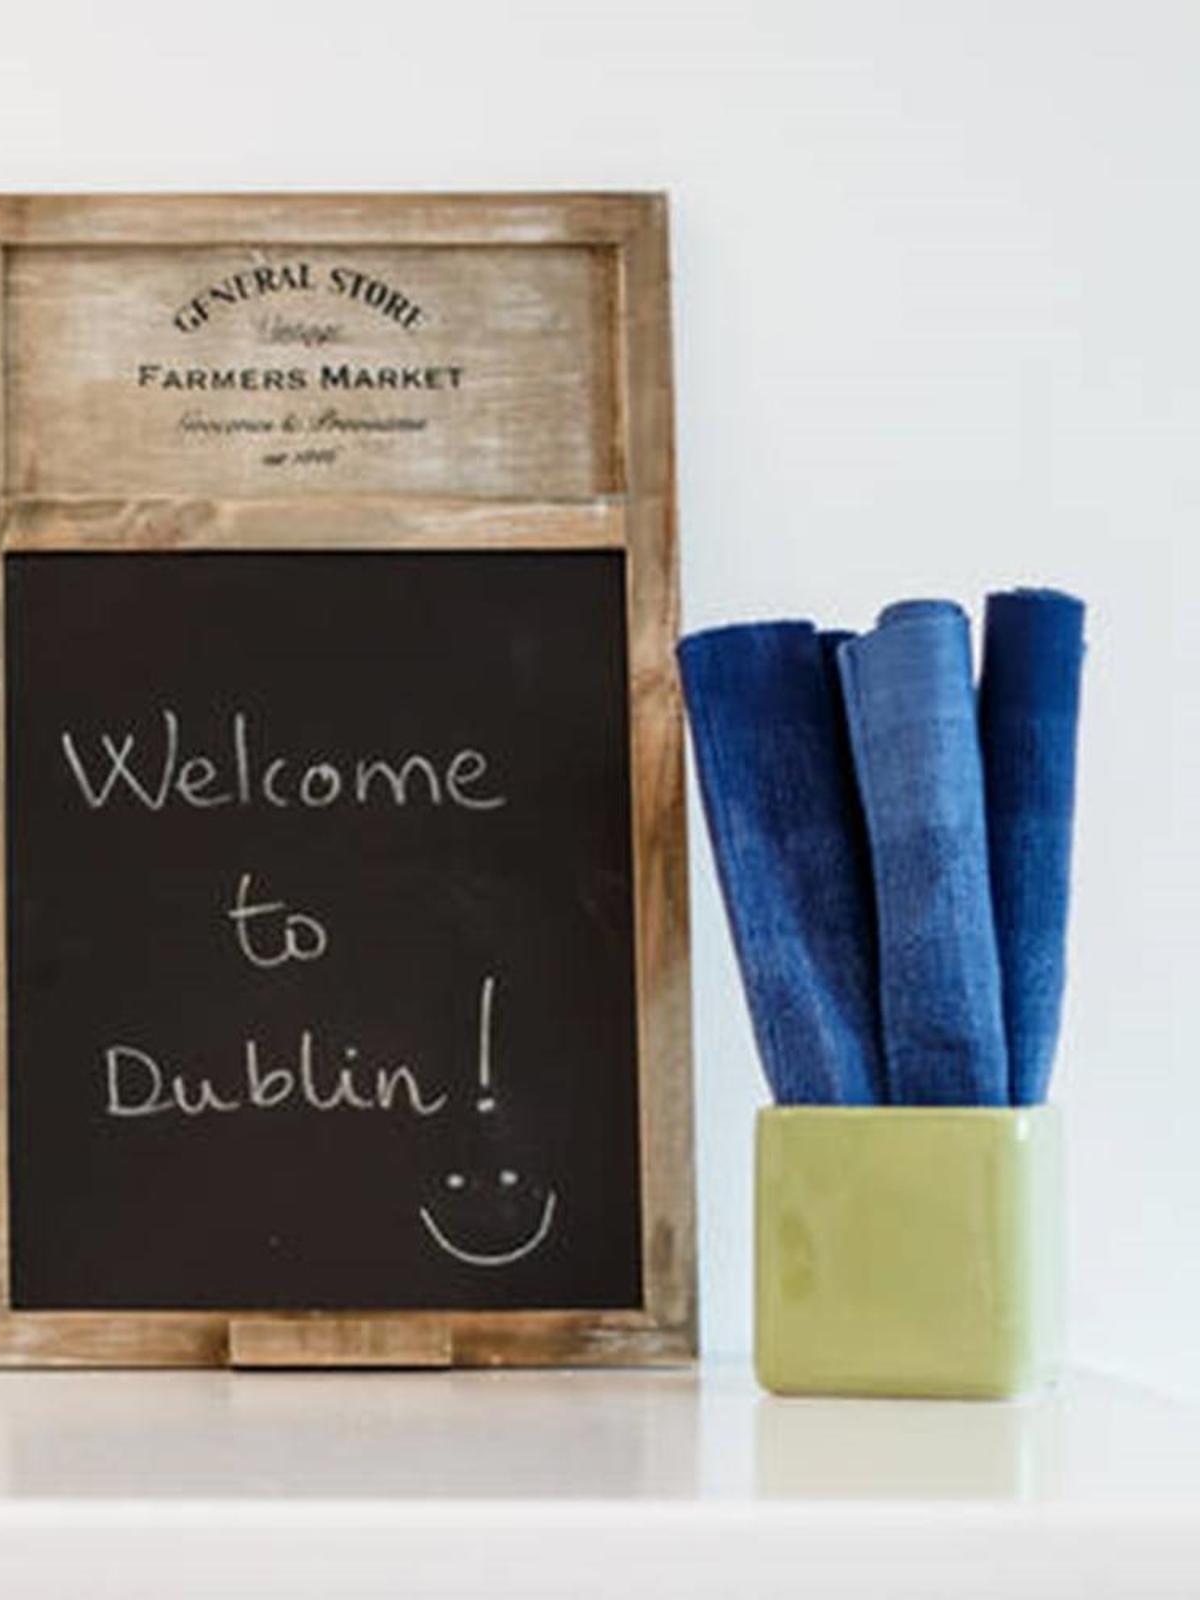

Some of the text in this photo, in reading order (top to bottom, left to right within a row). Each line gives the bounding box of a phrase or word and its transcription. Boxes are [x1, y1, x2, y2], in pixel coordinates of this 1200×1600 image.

[172, 262, 313, 333] GENERAL
[329, 267, 429, 332] STORE
[137, 363, 465, 391] FARMERS MARKET
[61, 710, 504, 810] Welcome
[227, 873, 328, 967] to
